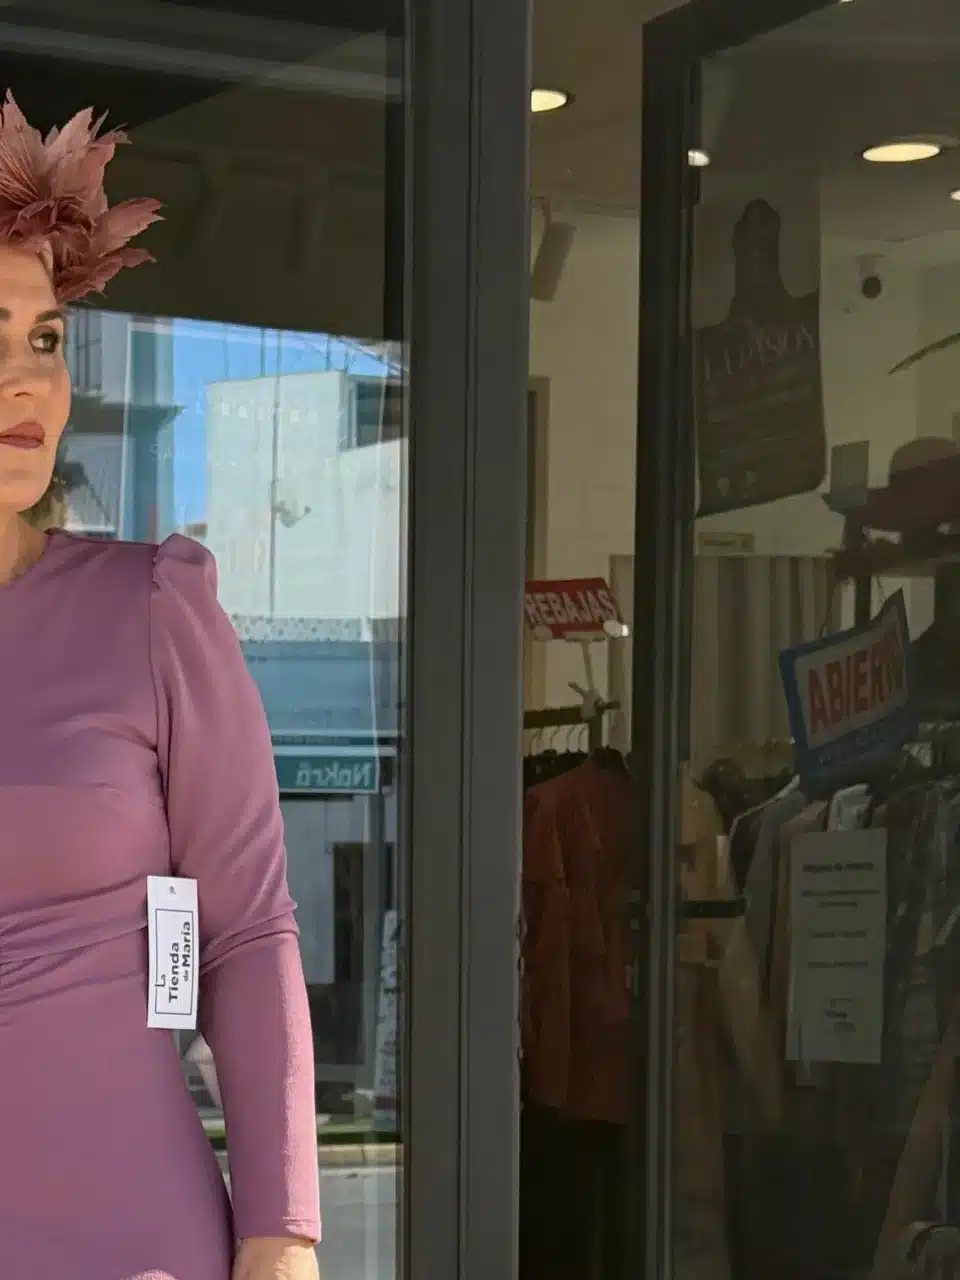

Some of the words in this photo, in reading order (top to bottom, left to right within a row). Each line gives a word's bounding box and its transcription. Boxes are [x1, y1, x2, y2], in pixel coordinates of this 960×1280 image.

[180, 921, 191, 968] María
[154, 973, 166, 988] La
[168, 942, 180, 1003] Tienda
